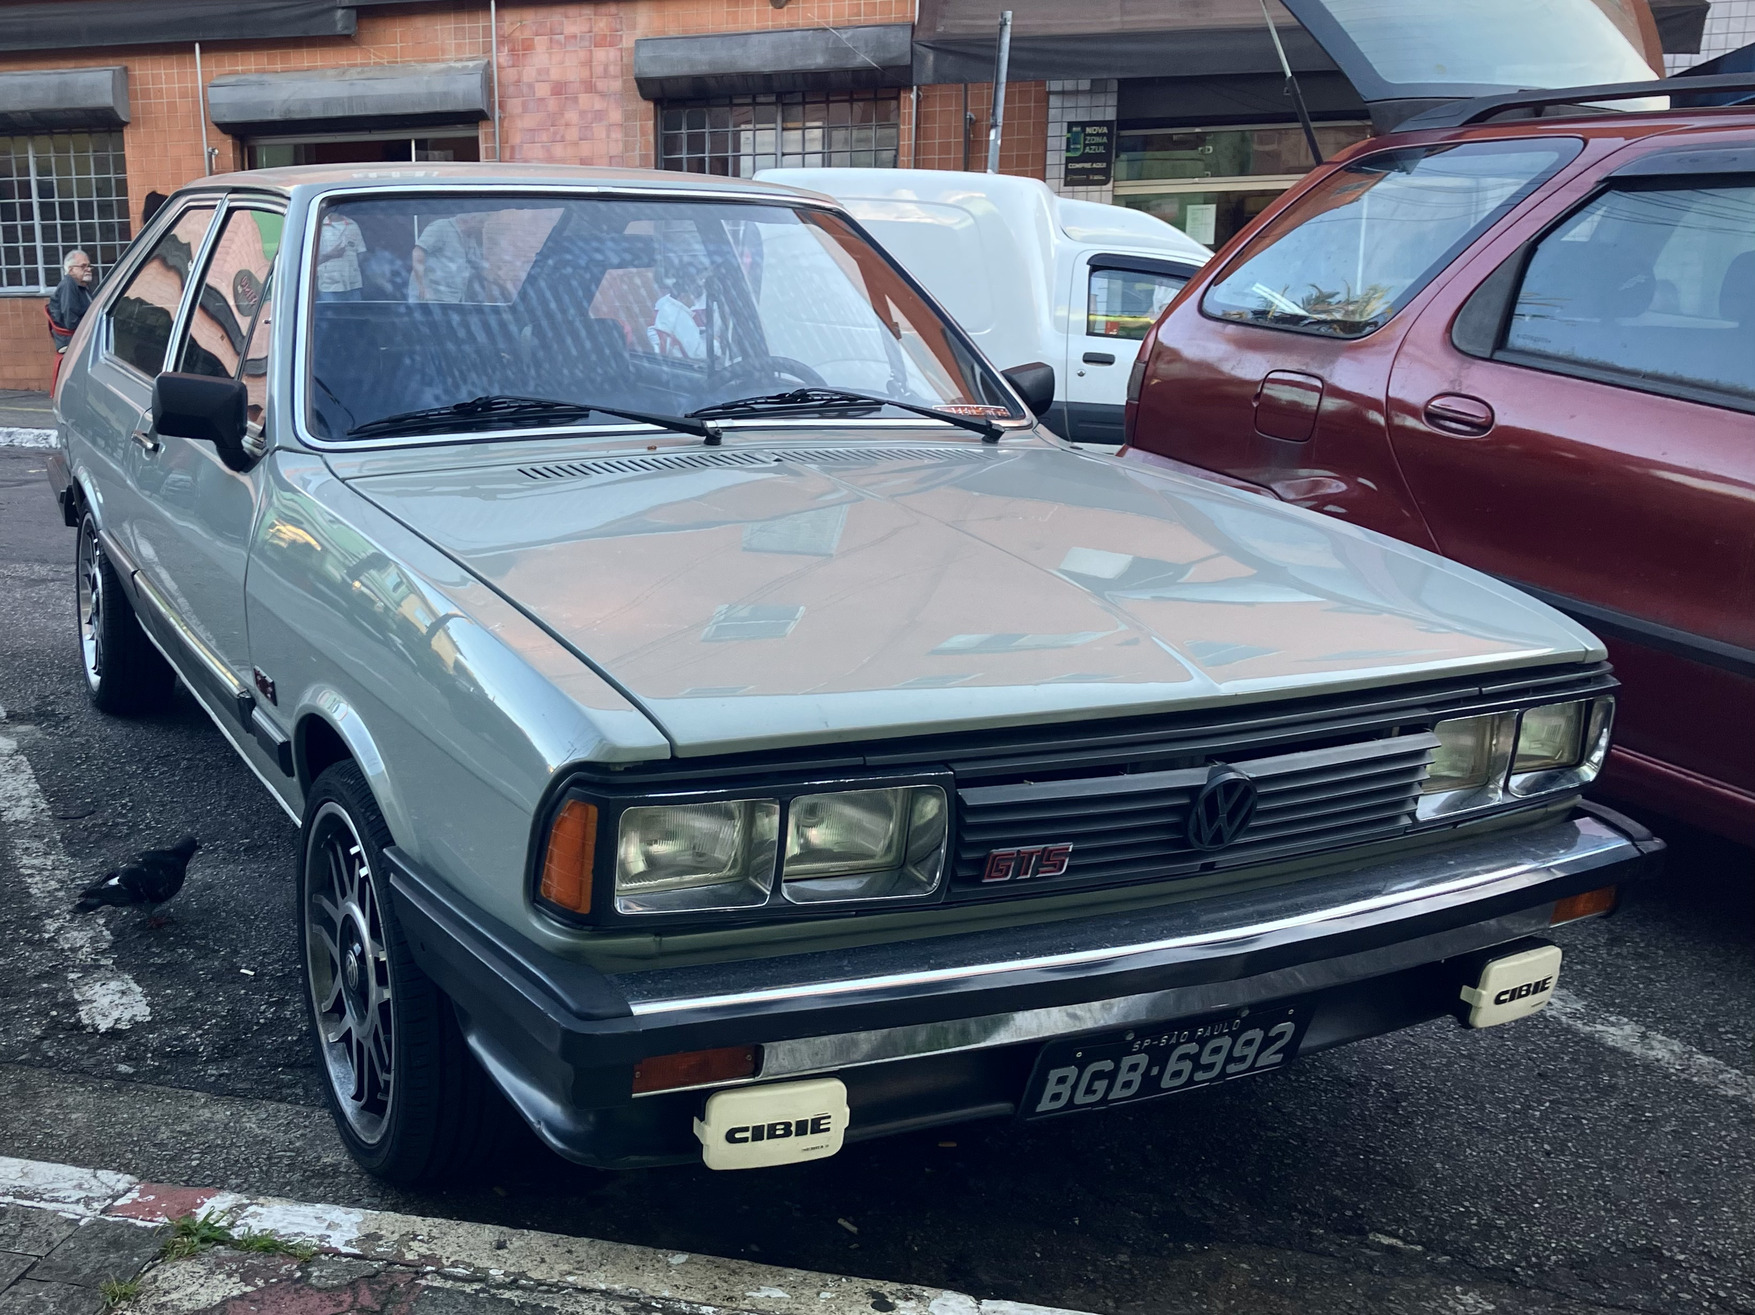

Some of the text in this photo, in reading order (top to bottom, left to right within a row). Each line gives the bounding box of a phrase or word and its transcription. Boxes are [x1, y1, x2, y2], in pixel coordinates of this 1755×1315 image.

[1085, 126, 1108, 134] NOVA
[1085, 136, 1108, 144] ZONA
[1084, 145, 1106, 153] AZUL
[982, 842, 1073, 882] GTS
[1194, 1019, 1240, 1039] PAULO
